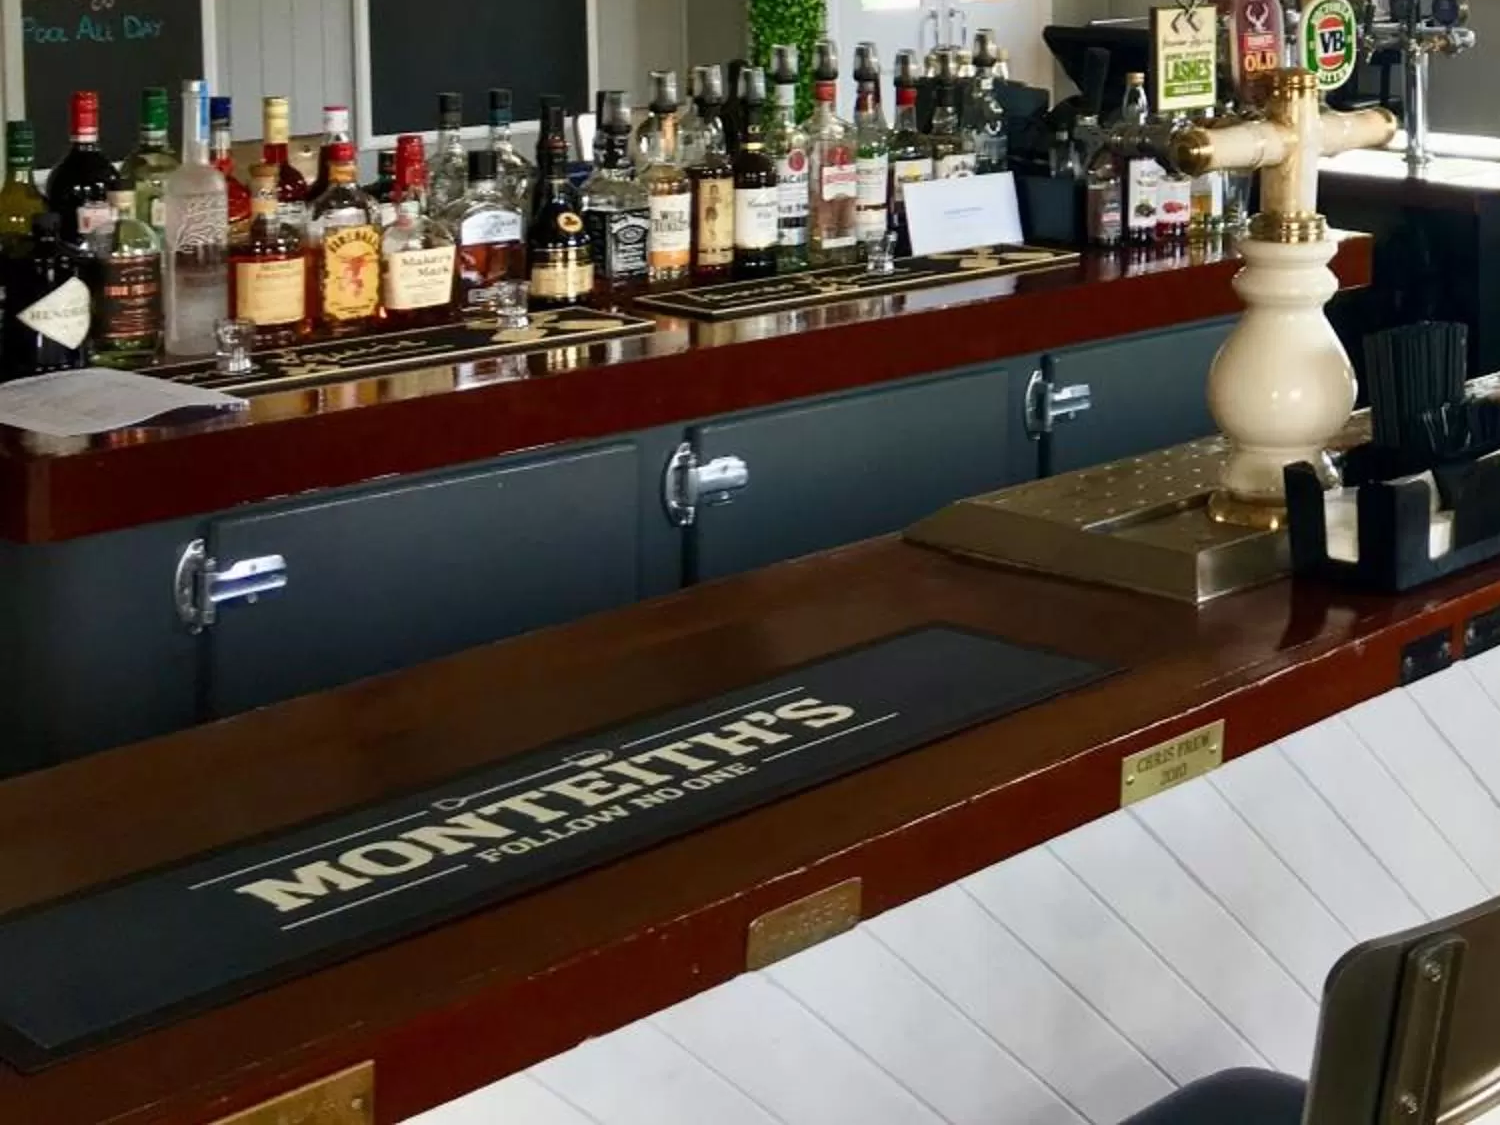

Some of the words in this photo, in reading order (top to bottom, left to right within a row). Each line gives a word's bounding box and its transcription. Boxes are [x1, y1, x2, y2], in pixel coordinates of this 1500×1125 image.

[1319, 30, 1346, 54] VB
[1244, 51, 1277, 72] OLD
[1136, 746, 1175, 774] CHRIS
[235, 697, 856, 914] MONTEITH'S
[475, 805, 632, 863] FOLLOW
[630, 787, 685, 809] NO
